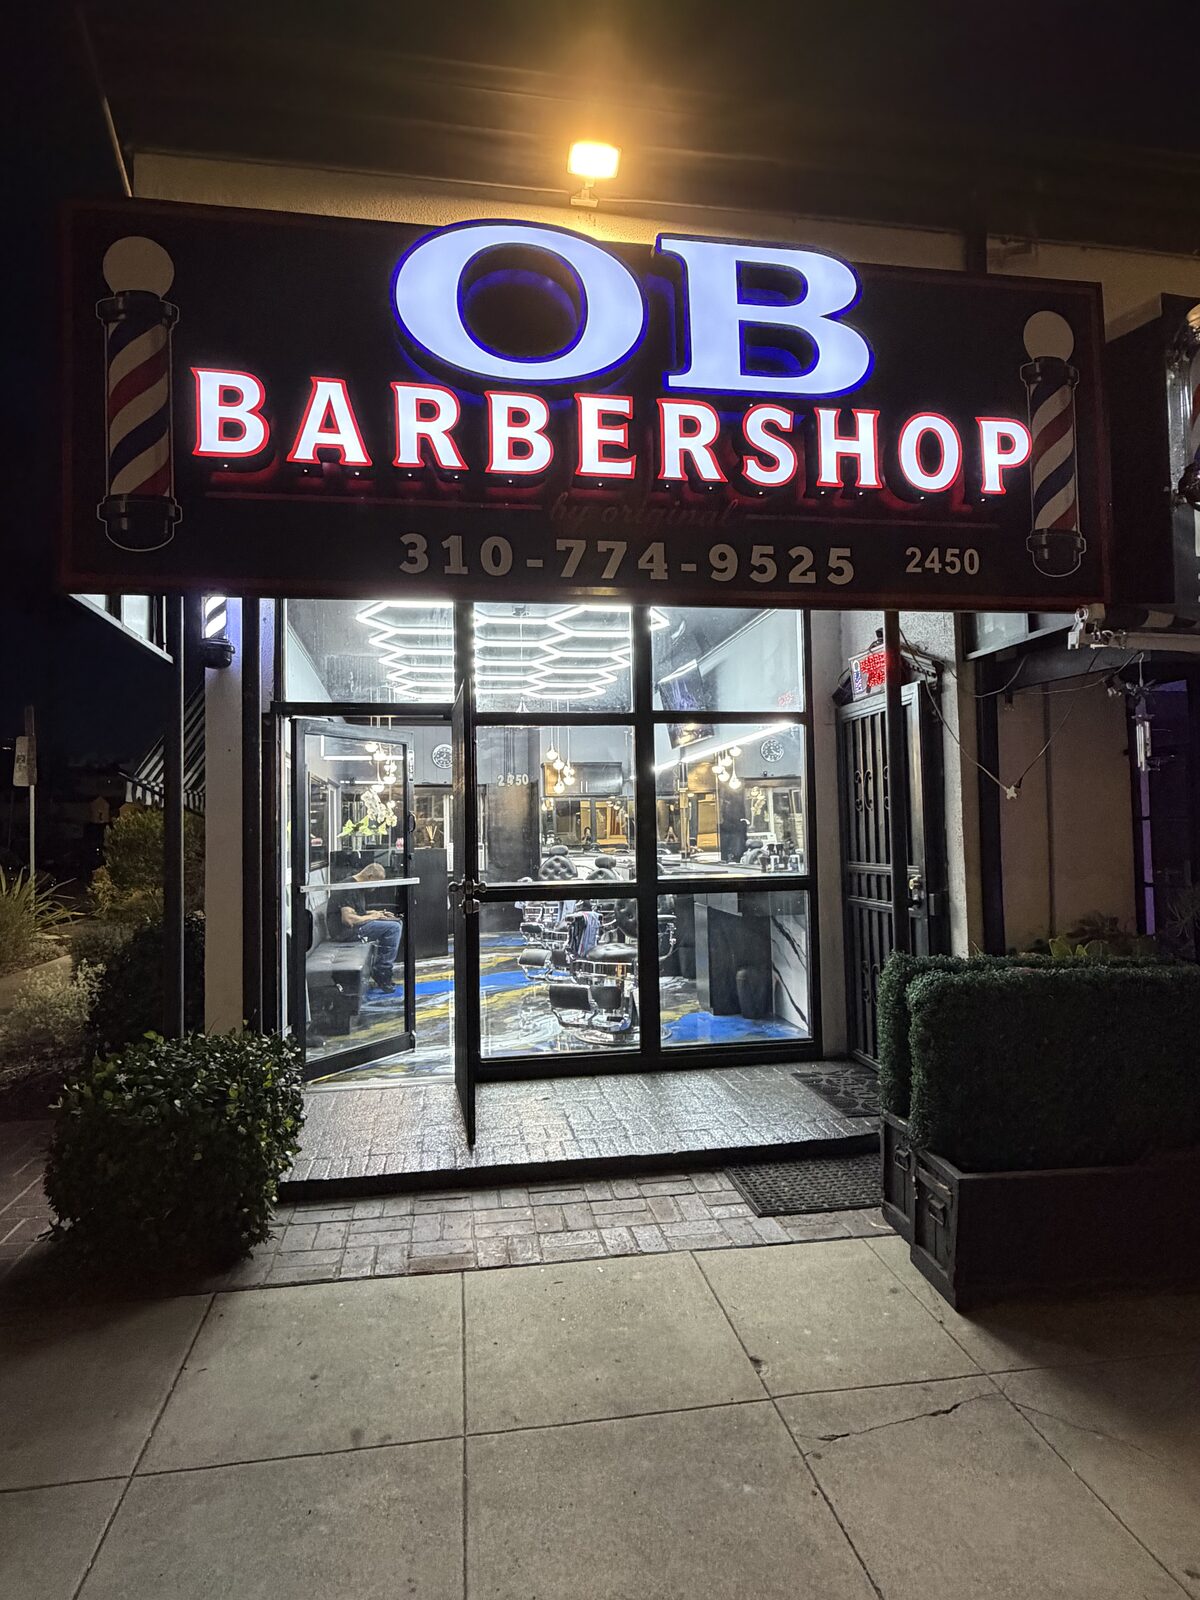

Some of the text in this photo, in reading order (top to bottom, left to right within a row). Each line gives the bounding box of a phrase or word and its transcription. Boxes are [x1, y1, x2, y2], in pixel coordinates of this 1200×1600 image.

[390, 219, 873, 398] OB
[191, 367, 1033, 495] BARBERSHOP
[399, 533, 855, 585] 310-774-9525
[905, 546, 980, 575] 2450
